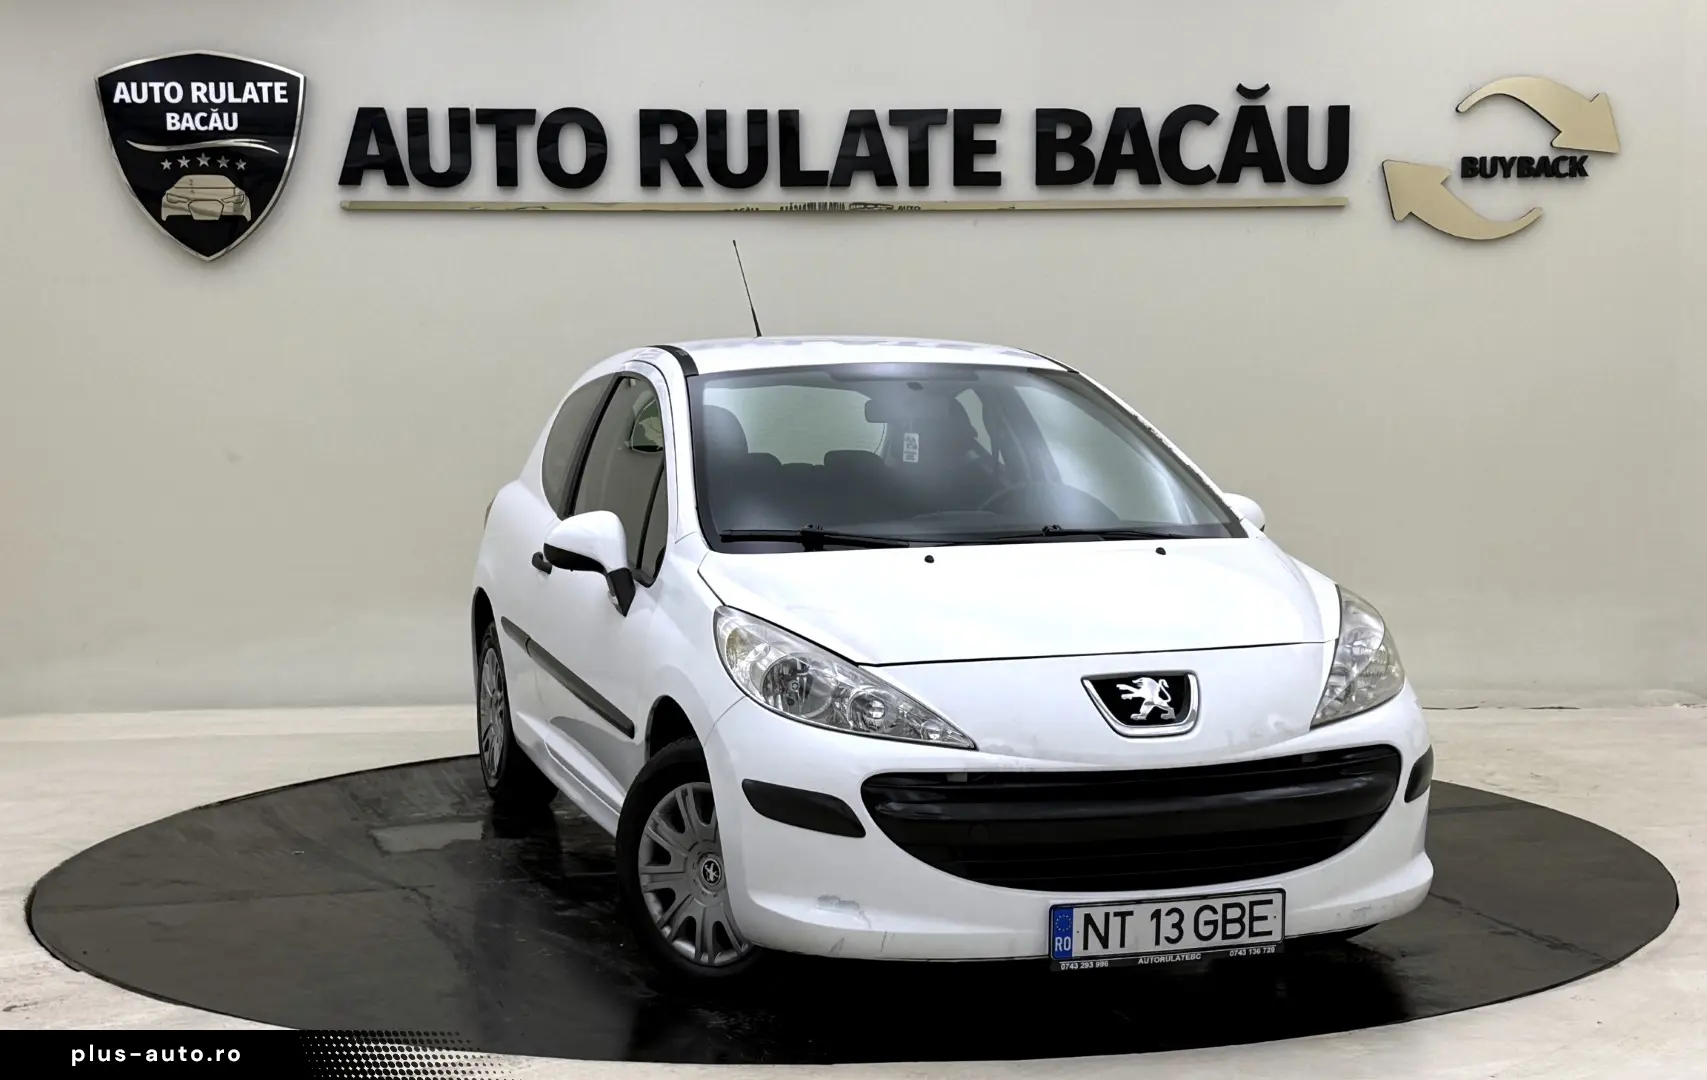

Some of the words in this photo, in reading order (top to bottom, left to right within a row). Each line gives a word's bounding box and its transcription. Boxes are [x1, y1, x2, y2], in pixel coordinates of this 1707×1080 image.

[113, 81, 184, 104] AUTO
[190, 81, 289, 104] RULATE
[165, 108, 239, 131] BACĂU
[338, 106, 608, 188] AUTO
[638, 107, 1002, 188] RULATE
[1035, 83, 1351, 187] BACĂU
[1460, 154, 1590, 179] BUYBACK
[1082, 910, 1134, 951] NT
[1150, 907, 1185, 946] 13
[1193, 898, 1274, 942] GBE
[1054, 936, 1072, 952] RO
